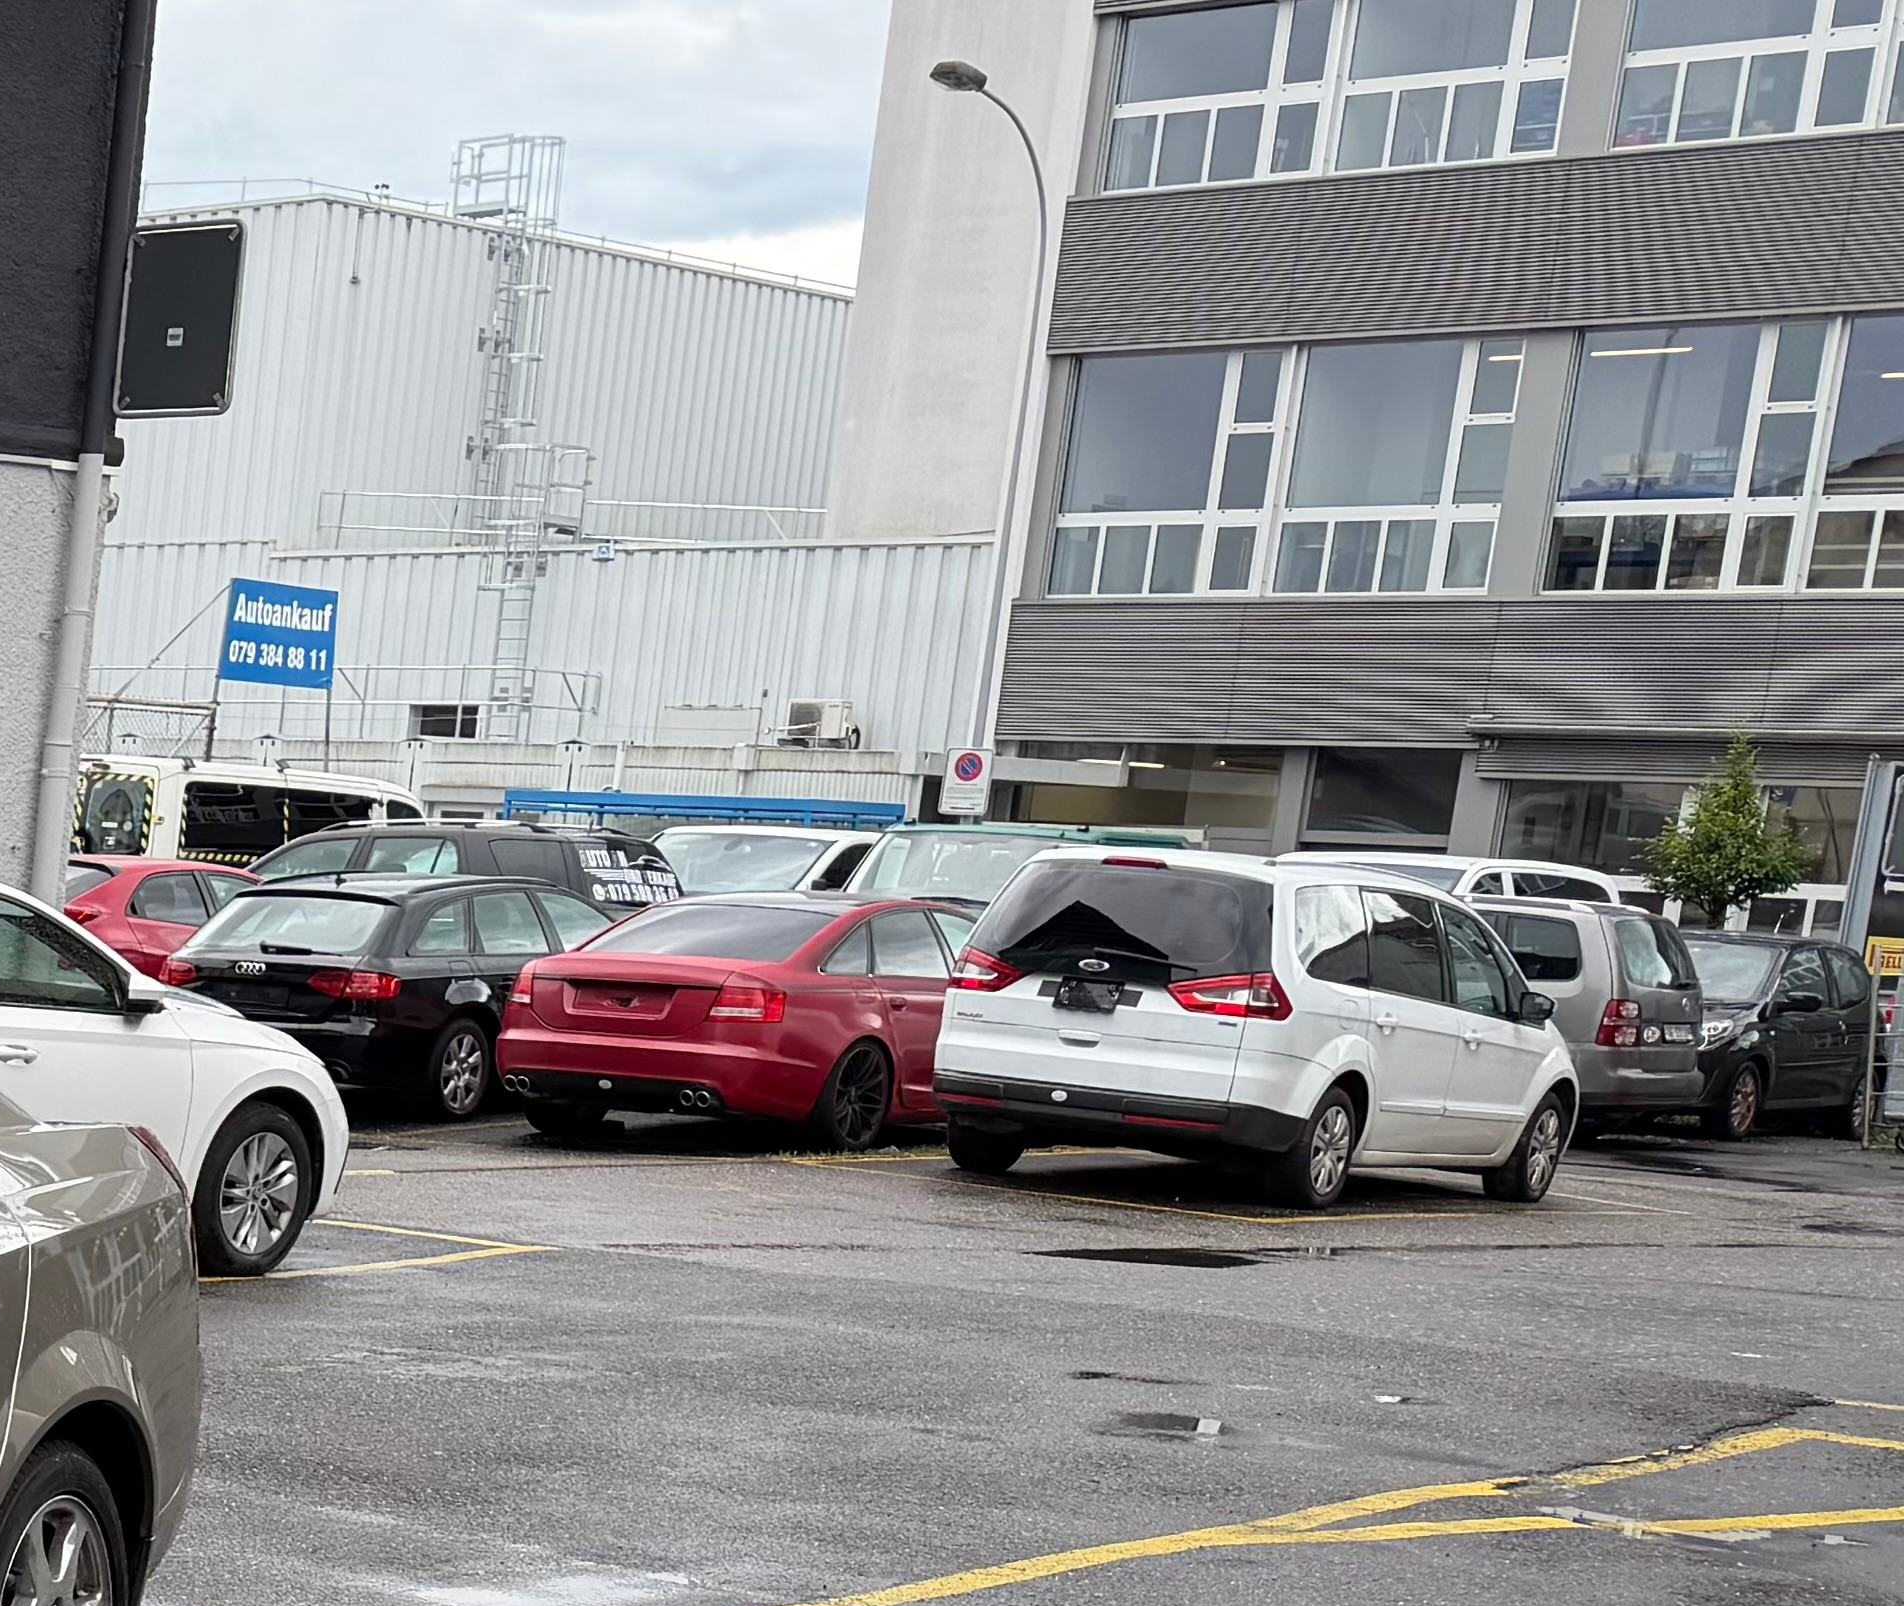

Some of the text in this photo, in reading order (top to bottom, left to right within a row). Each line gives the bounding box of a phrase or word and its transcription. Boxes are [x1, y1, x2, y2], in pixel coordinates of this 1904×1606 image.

[233, 592, 332, 632] Autoankauf
[229, 639, 327, 671] 079 384 88 11
